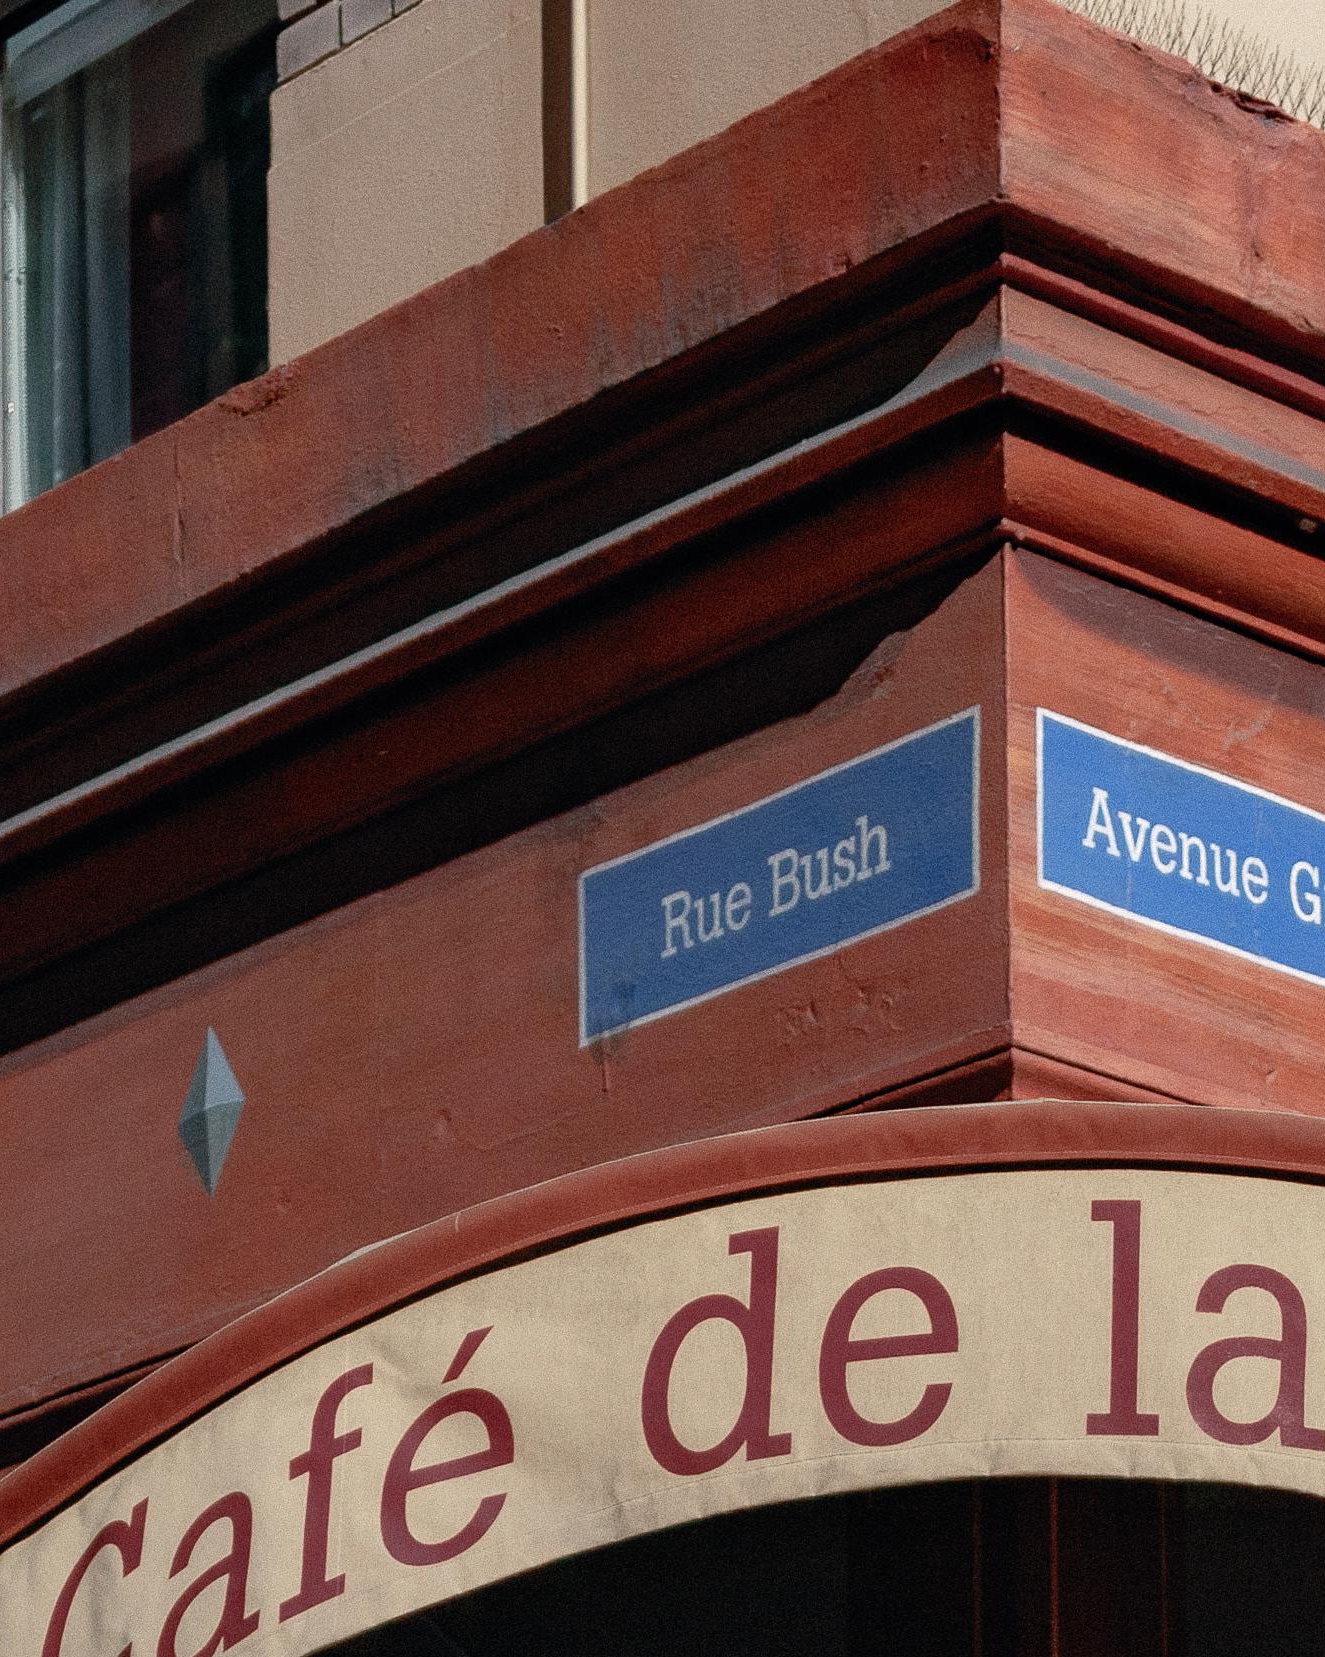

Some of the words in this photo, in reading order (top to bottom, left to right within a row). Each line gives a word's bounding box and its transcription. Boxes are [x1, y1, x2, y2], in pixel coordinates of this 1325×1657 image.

[659, 882, 753, 960] Rue
[767, 814, 891, 917] Bush
[1081, 787, 1271, 907] Avenue
[640, 1226, 960, 1477] de
